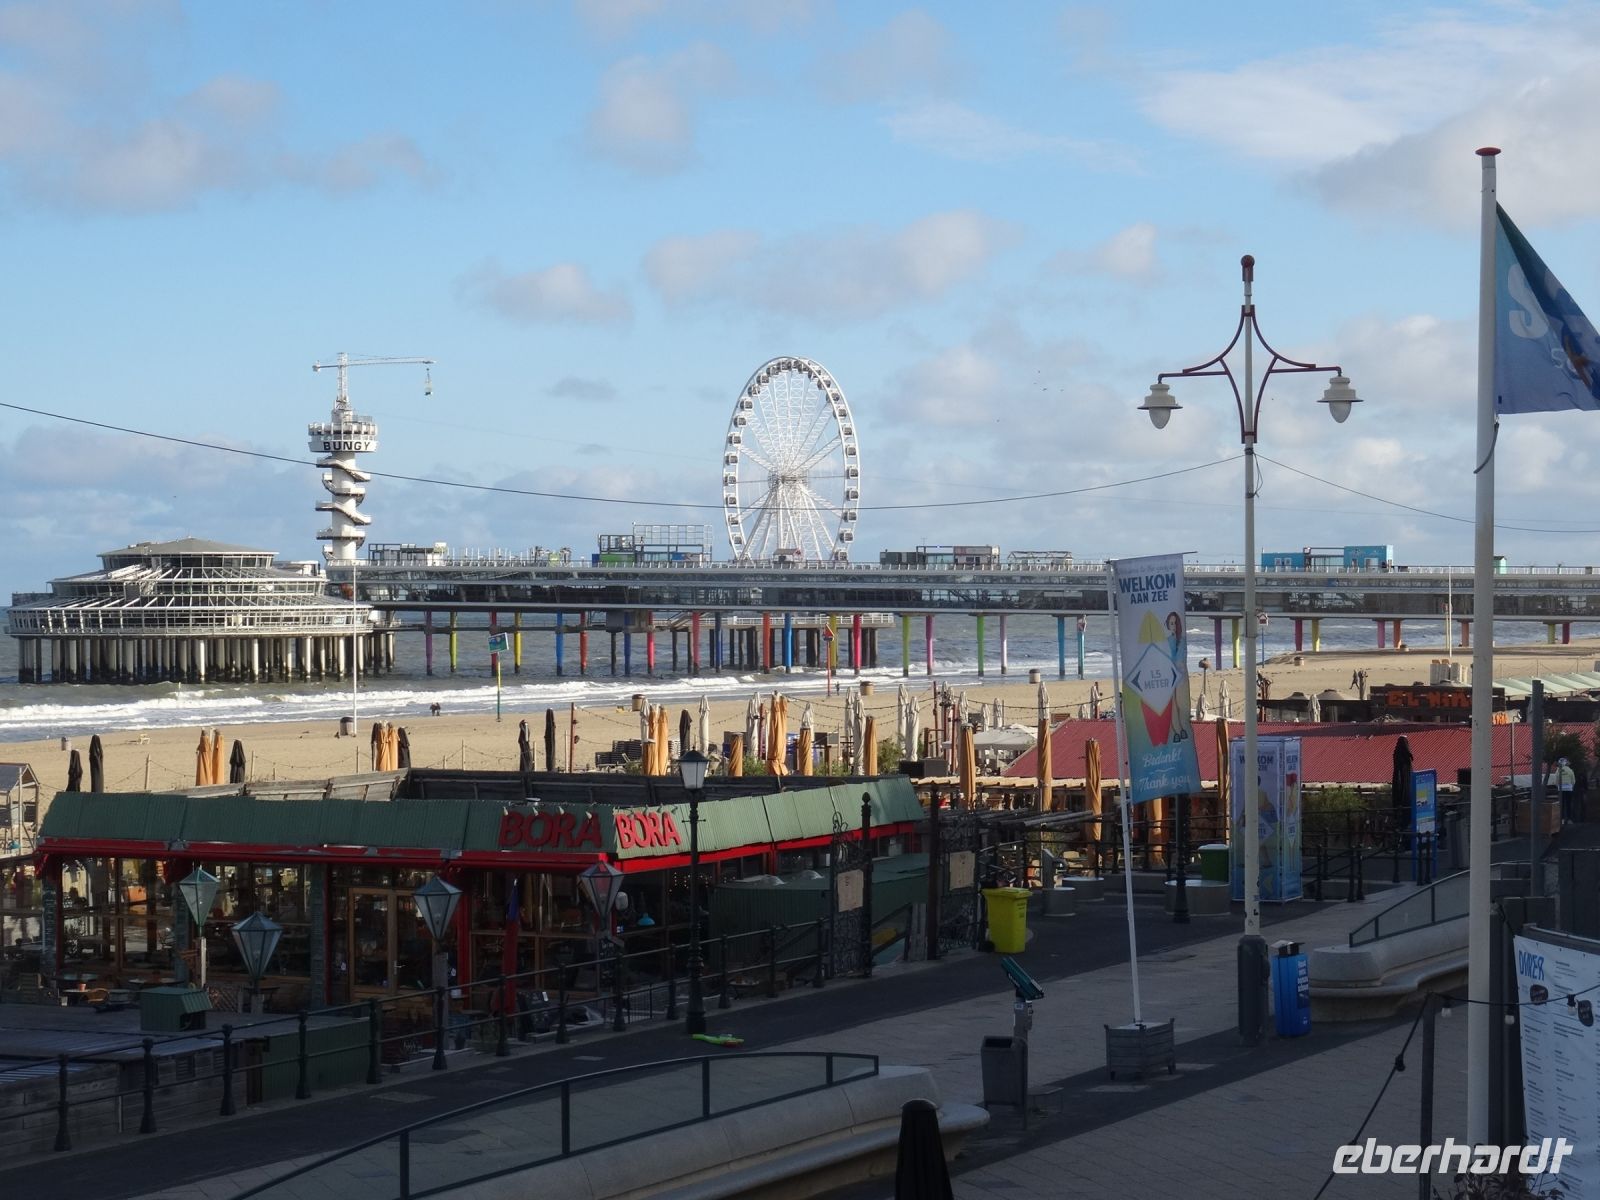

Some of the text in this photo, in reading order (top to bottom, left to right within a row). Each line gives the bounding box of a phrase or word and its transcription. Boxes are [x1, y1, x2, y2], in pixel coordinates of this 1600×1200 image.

[323, 441, 371, 451] BUNGY
[1119, 573, 1176, 593] WELKOM
[1130, 590, 1169, 605] AAN ZEE
[1143, 678, 1169, 690] METER
[1386, 690, 1420, 708] EL
[1139, 773, 1191, 792] Thank you
[499, 811, 603, 848] BORA
[615, 811, 682, 849] BORA
